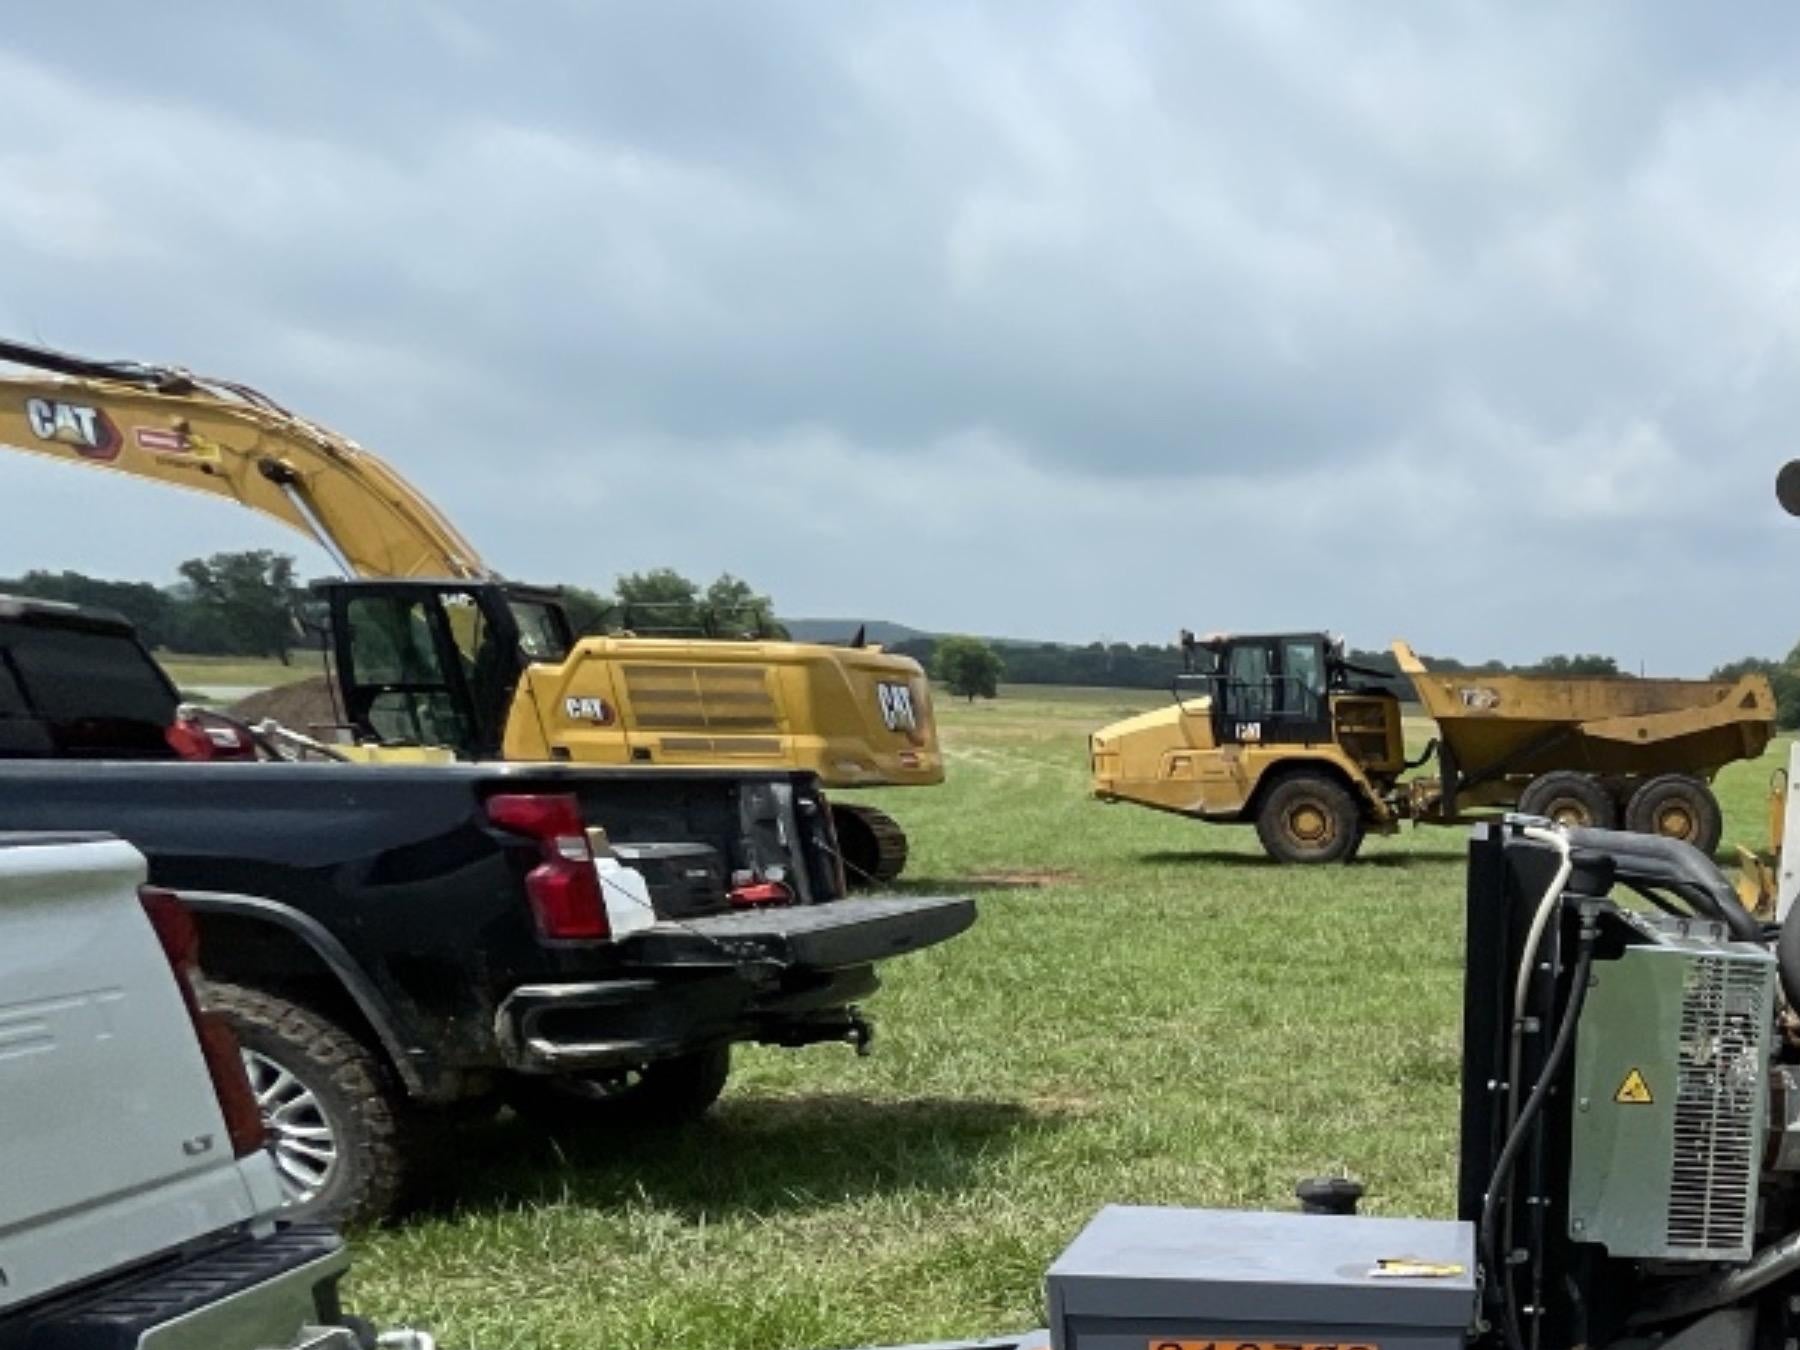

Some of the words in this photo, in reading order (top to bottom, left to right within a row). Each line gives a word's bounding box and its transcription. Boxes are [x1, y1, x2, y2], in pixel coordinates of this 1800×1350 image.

[27, 398, 97, 446] CAT
[567, 697, 604, 720] CAT
[878, 683, 916, 730] CAT
